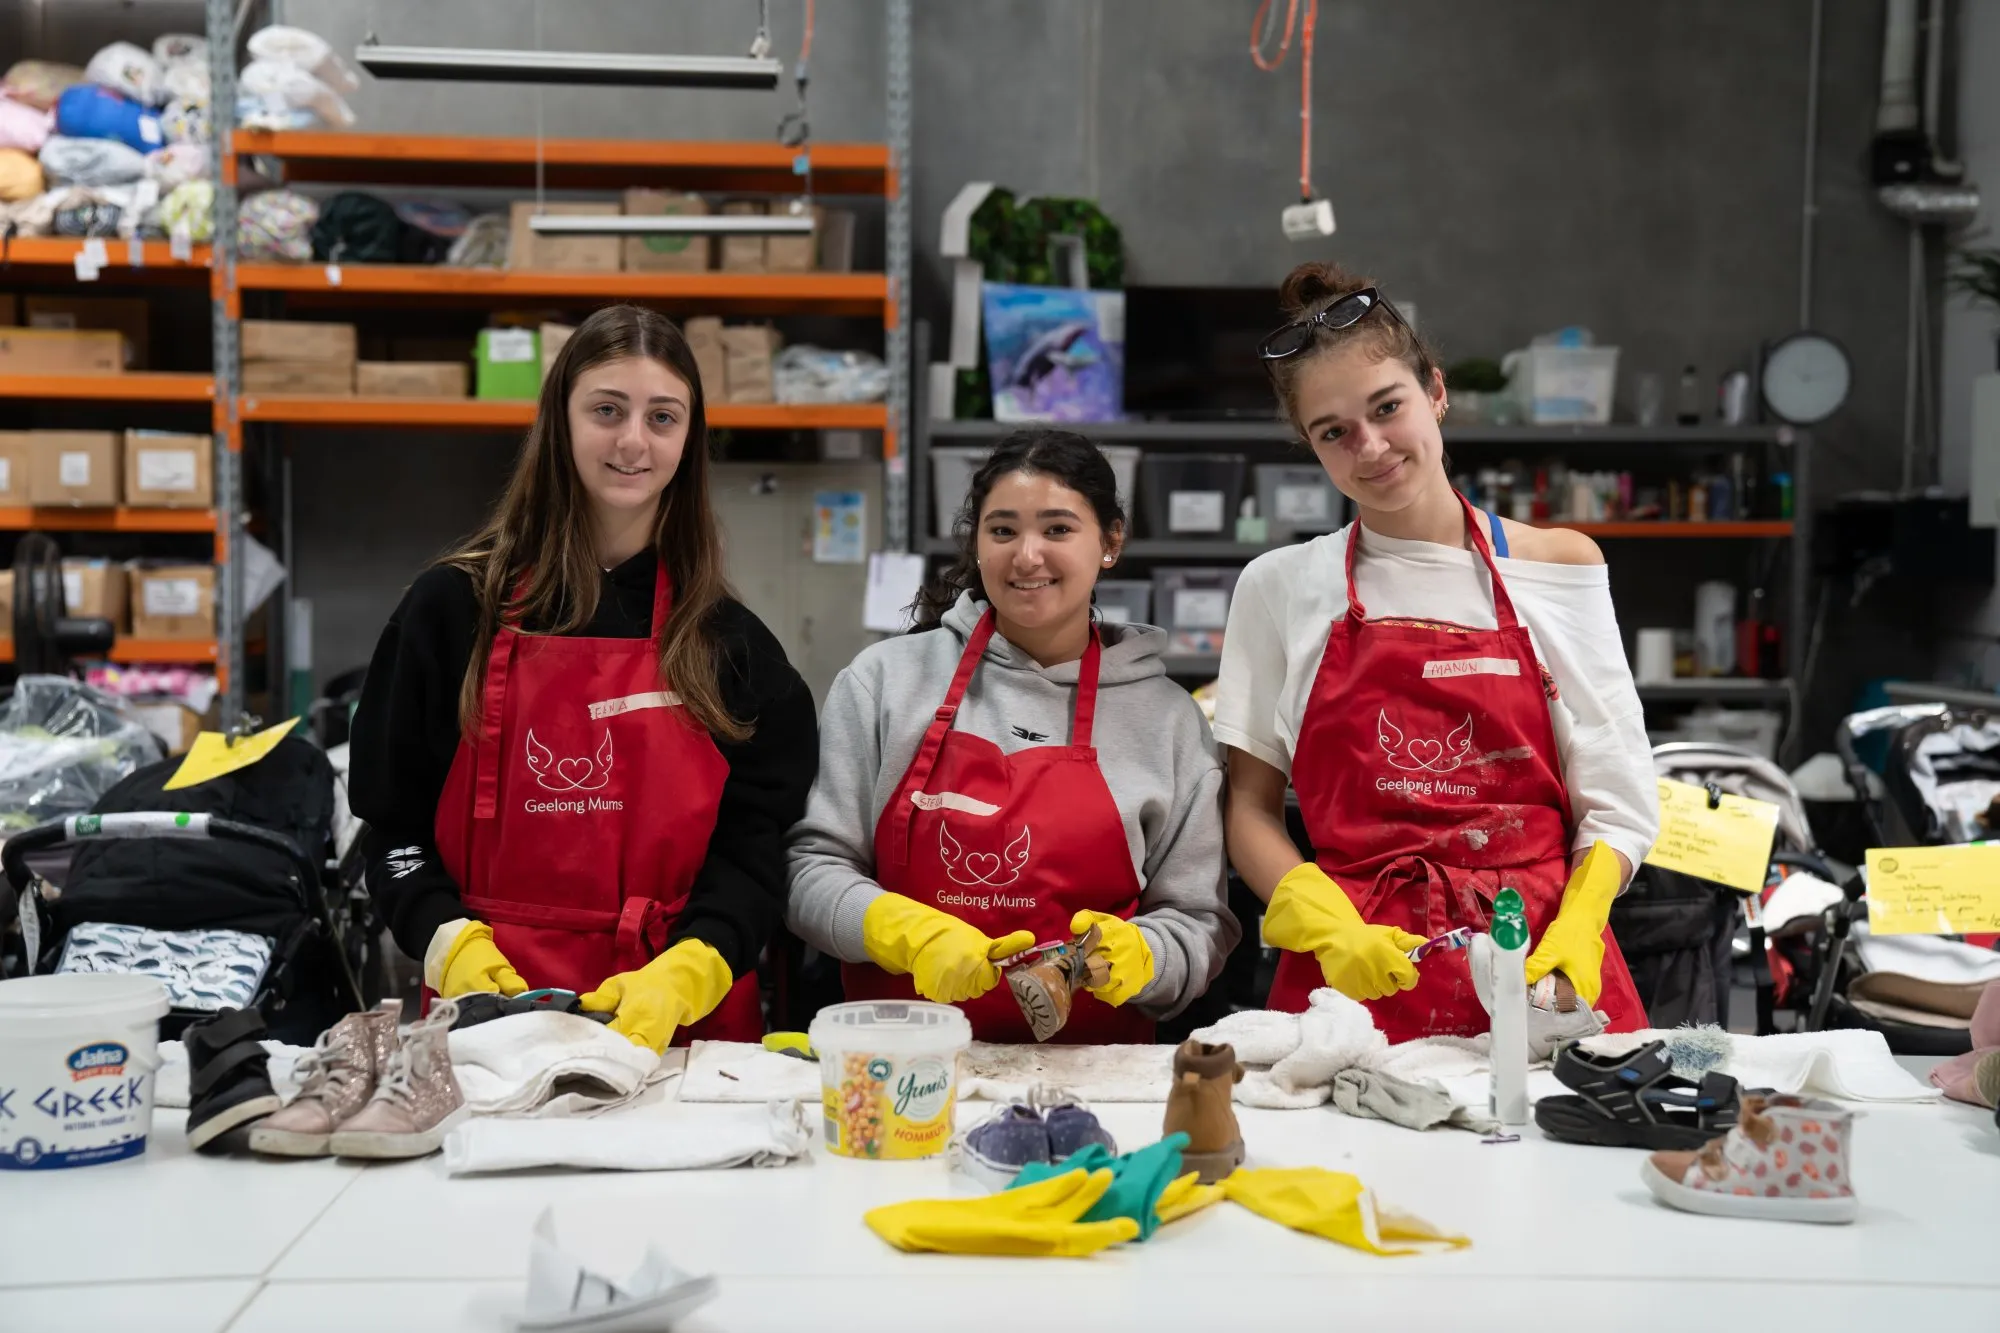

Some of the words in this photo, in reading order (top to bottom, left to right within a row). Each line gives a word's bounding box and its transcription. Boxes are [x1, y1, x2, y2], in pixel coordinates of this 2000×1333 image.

[1431, 662, 1478, 676] MANON
[1375, 776, 1432, 794] Geelong
[1435, 779, 1477, 796] Mums
[524, 797, 585, 814] Geelong
[588, 796, 624, 811] Mums
[936, 889, 990, 910] Geelong
[992, 892, 1036, 908] Mums
[33, 1075, 145, 1119] GREEK
